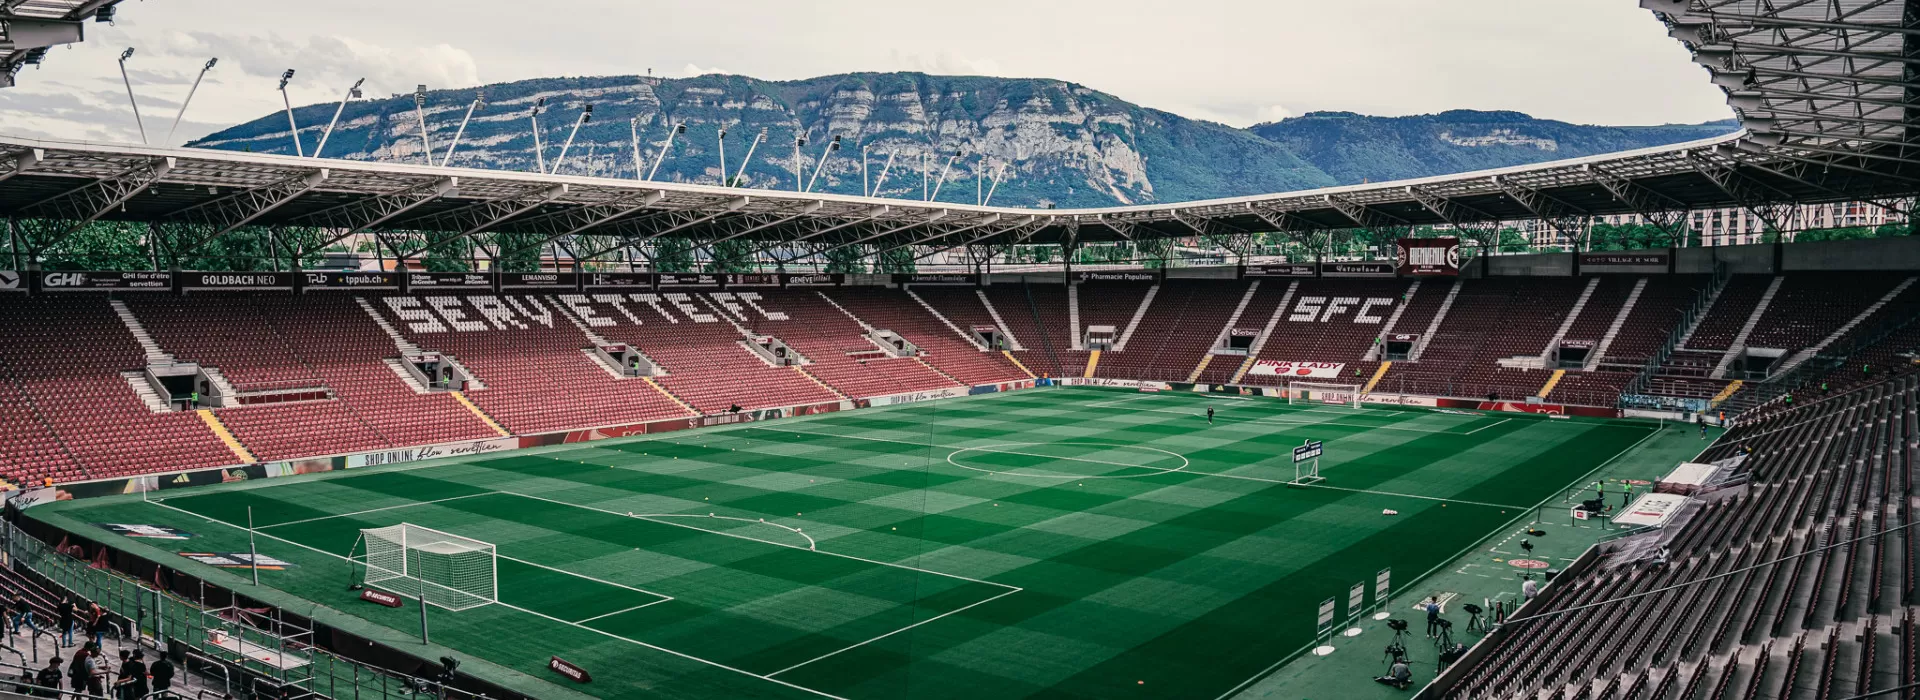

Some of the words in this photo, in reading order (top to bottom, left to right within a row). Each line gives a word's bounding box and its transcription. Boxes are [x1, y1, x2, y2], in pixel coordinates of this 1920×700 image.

[1409, 247, 1446, 266] BIENVENUE
[44, 272, 83, 287] GHI
[202, 275, 254, 285] GOLDBACH
[257, 275, 276, 285] NEO
[345, 274, 382, 285] tppub.ch
[1124, 273, 1153, 281] Populaire
[710, 292, 789, 321] FC
[1289, 296, 1393, 324] SFC
[1257, 359, 1293, 368] PINK
[365, 453, 385, 466] SHOP
[387, 450, 414, 464] ONLINE
[371, 591, 396, 603] SECURITAS
[558, 663, 583, 680] SECURITAS
